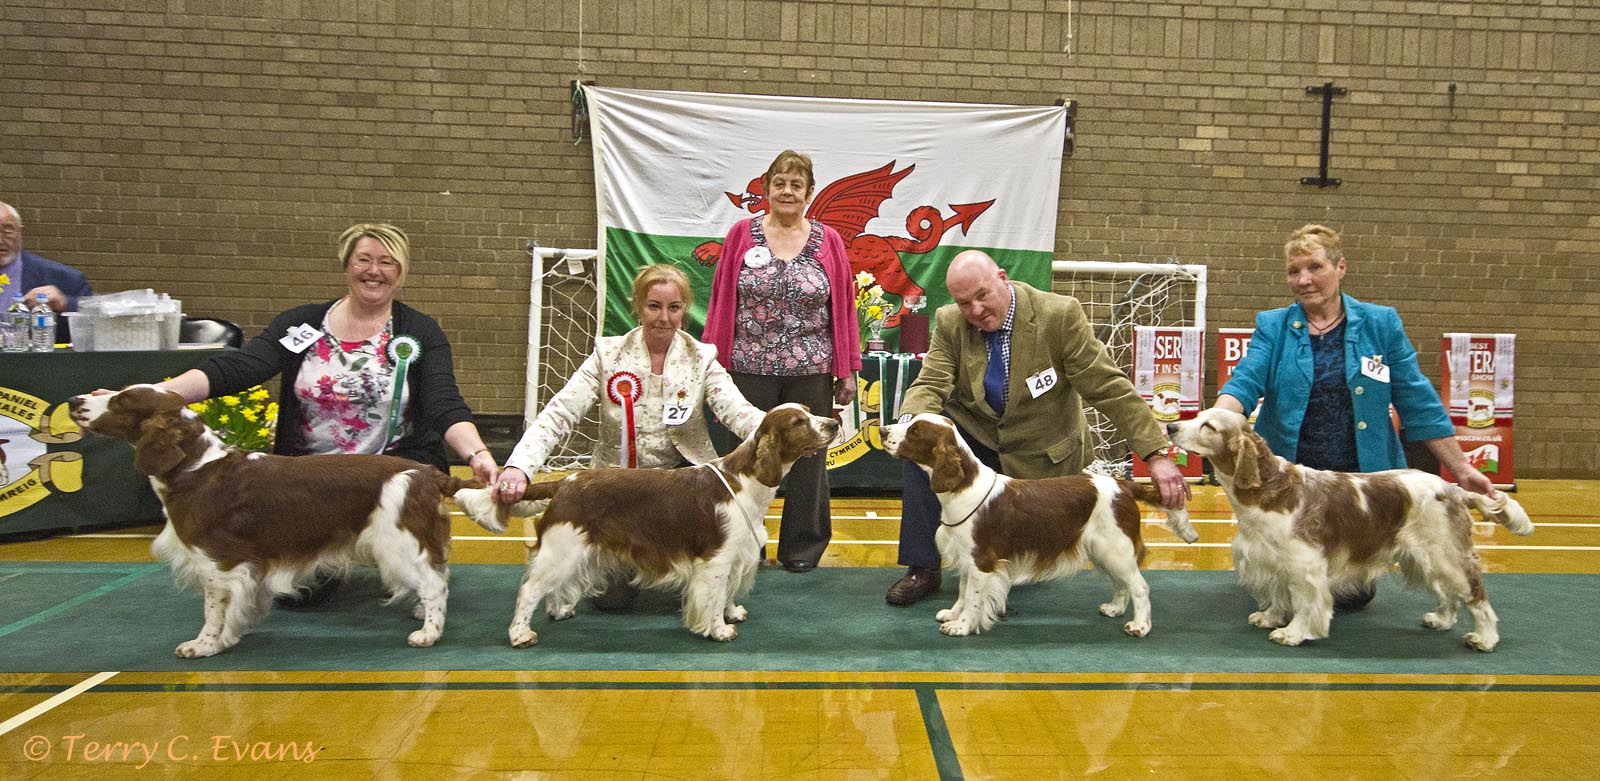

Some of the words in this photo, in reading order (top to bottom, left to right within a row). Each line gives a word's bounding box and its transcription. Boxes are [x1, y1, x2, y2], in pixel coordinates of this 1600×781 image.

[292, 329, 314, 347] 46
[1035, 374, 1054, 391] 48
[667, 406, 689, 420] 27
[829, 437, 862, 458] CYMREIG
